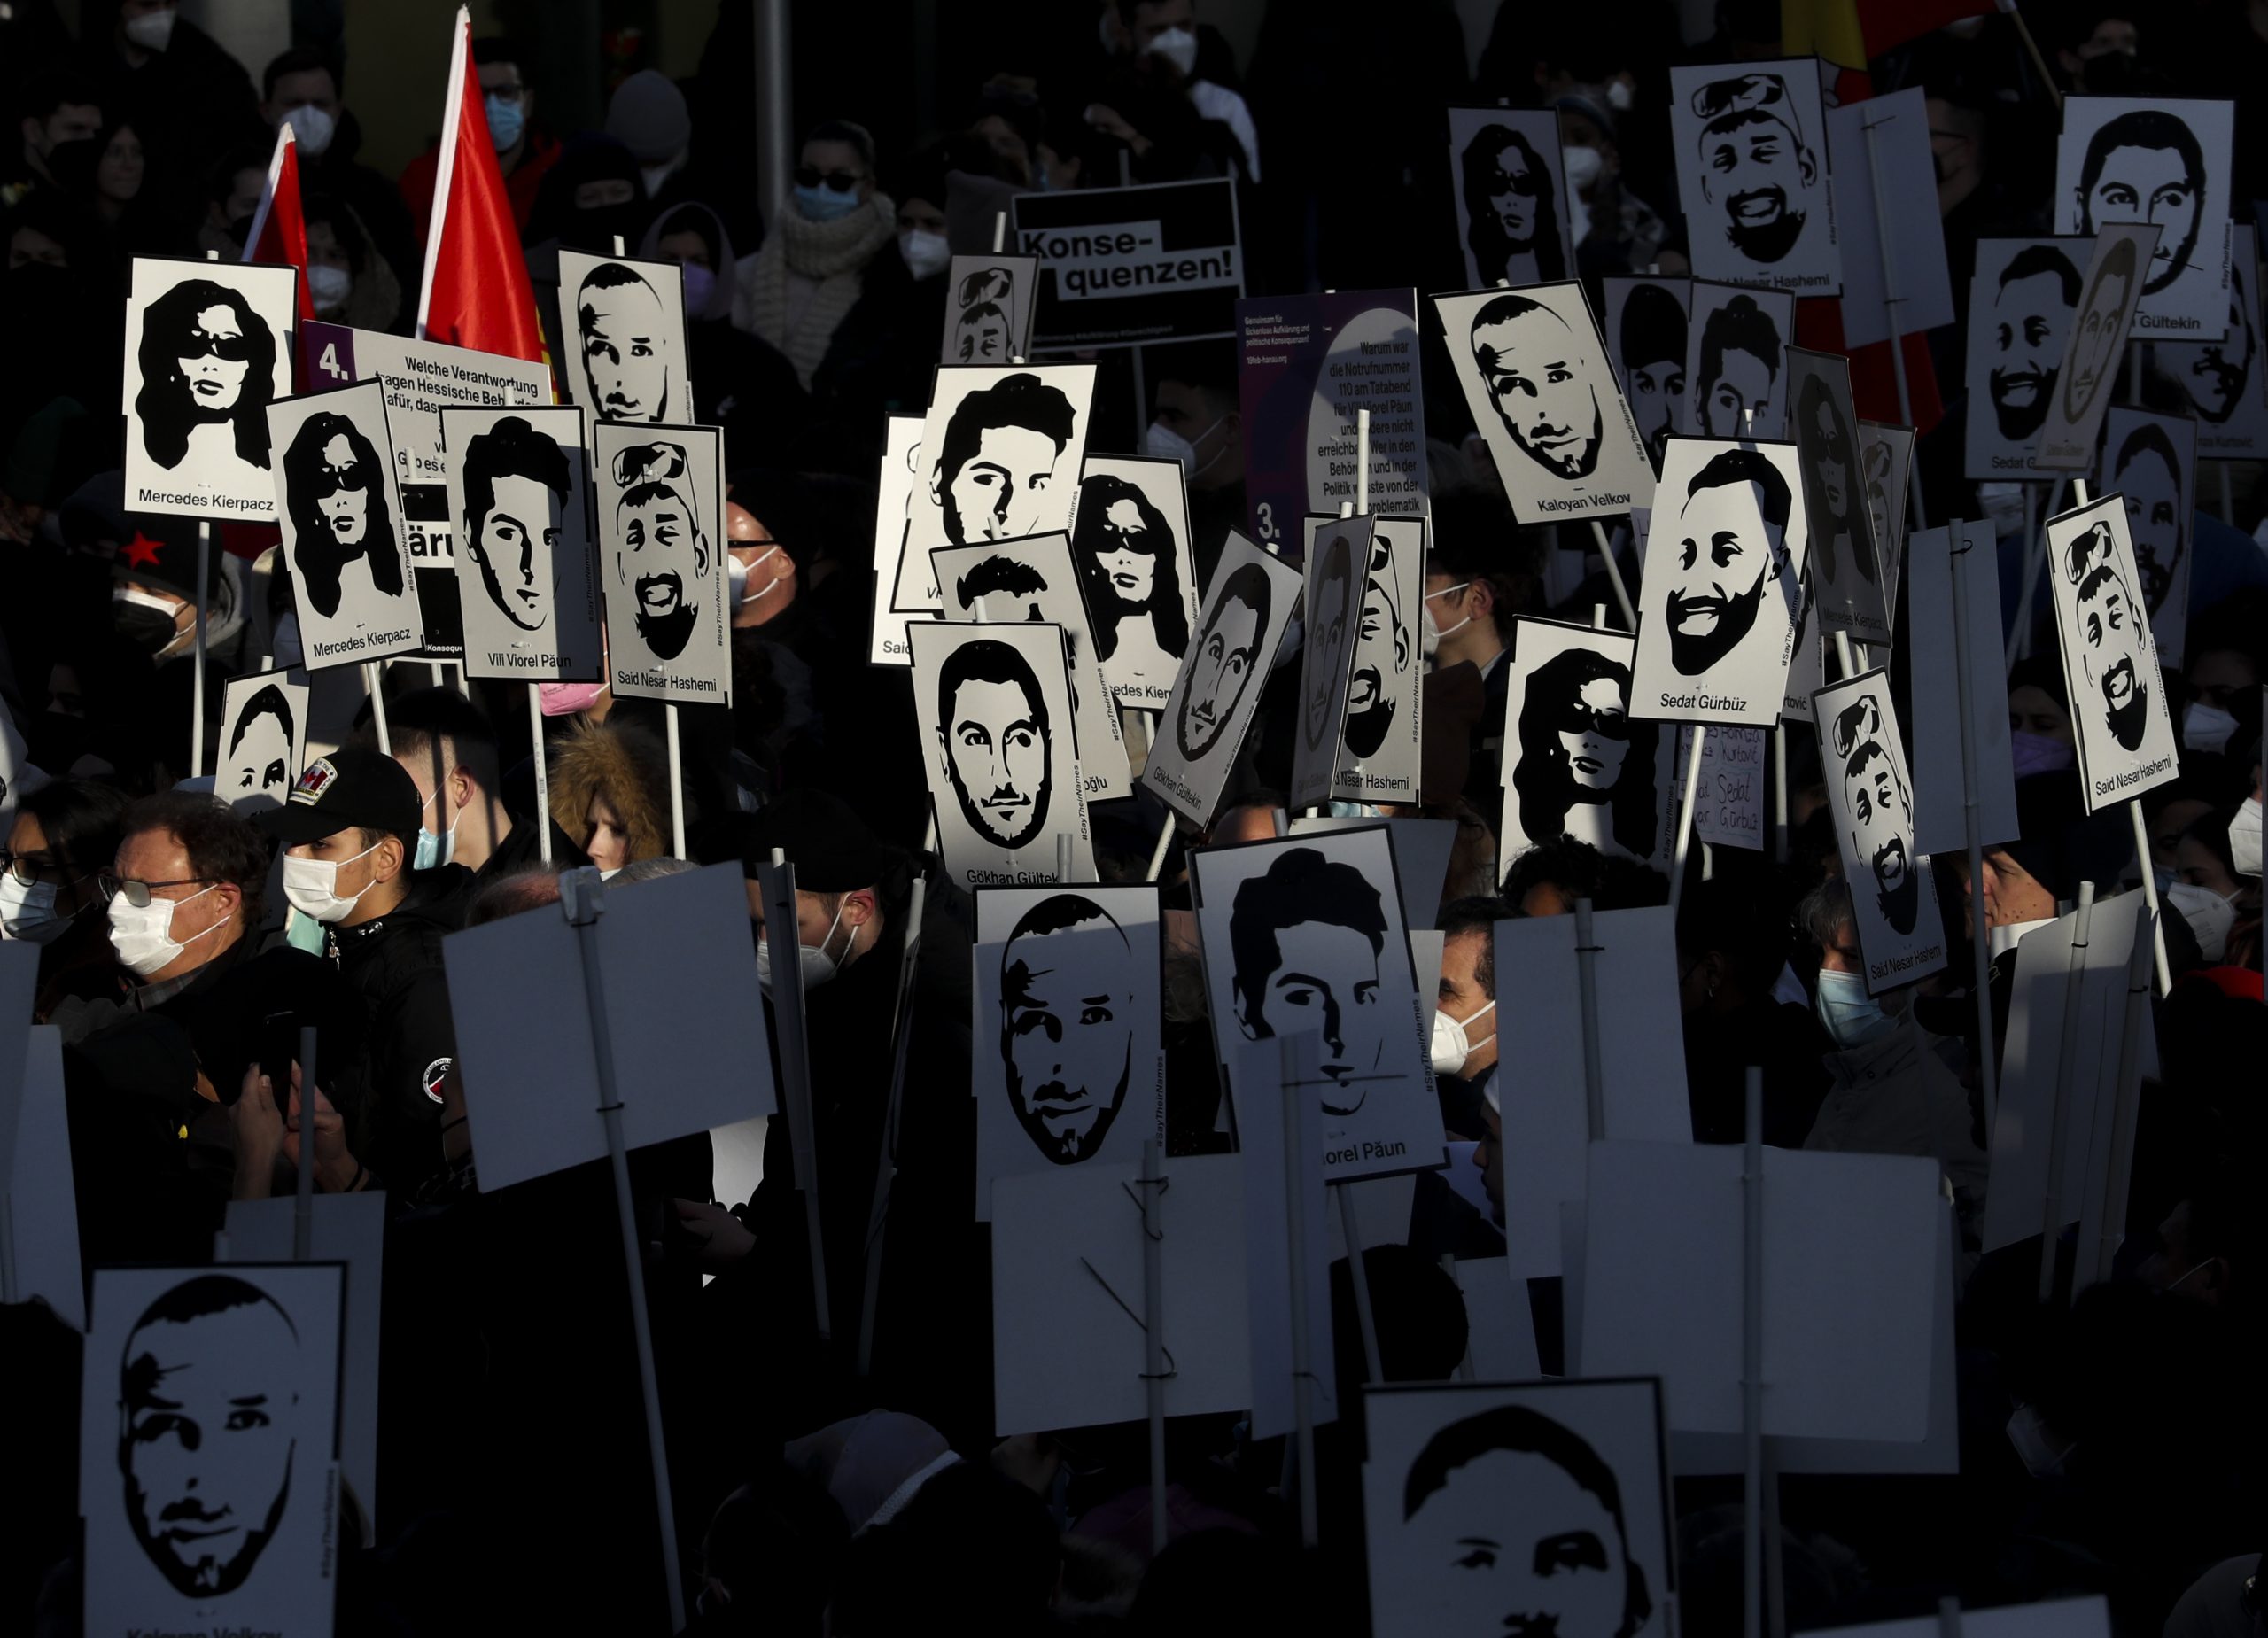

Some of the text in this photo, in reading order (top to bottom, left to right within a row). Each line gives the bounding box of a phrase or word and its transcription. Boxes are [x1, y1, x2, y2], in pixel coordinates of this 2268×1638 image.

[1024, 231, 1152, 259] Konse-
[2221, 223, 2233, 290] #SayTheirNames
[1066, 250, 1231, 297] quenzen!
[1774, 274, 1829, 288] Hashemi
[2140, 315, 2201, 330] Gültekin
[318, 342, 349, 381] 4.
[1360, 342, 1410, 356] Warum war
[405, 356, 538, 398] Welche Verantwortung
[1330, 361, 1410, 377] die Notrufnummer
[417, 377, 479, 402] Hessische
[1339, 379, 1411, 396] 110 am Tatabend
[1334, 403, 1347, 416] für
[1341, 423, 1357, 436] und
[1391, 419, 1414, 433] nicht
[1619, 399, 1645, 462] #SayTheirNames
[1389, 441, 1397, 453] in
[1398, 439, 1416, 453] den
[424, 459, 439, 472] es
[1374, 462, 1391, 475] und
[1392, 461, 1401, 473] in
[1402, 460, 1418, 472] der
[1992, 456, 2024, 470] Sedat
[139, 488, 275, 512] Mercedes Kierpacz
[1324, 482, 1351, 496] Politik
[1386, 482, 1402, 493] von
[1403, 479, 1418, 493] der
[1537, 493, 1632, 512] Kaloyan Velkov
[1256, 501, 1281, 540] 3.
[400, 518, 415, 592] #SayTheirNames
[584, 547, 595, 622] #SayTheirNames
[1782, 589, 1800, 666] #SayTheirNames
[314, 627, 412, 658] Mercedes Kierpacz
[488, 652, 572, 668] Vili Viorel Păun
[618, 671, 717, 693] Said Nesar Hashemi
[1097, 667, 1119, 741] #SayTheirNames
[1660, 693, 1747, 711] Sedat Gürbüz
[1224, 705, 1255, 775] #SayTheirNames
[1153, 766, 1202, 810] Gökhan Gültekin
[1340, 772, 1364, 788] Nesar
[1366, 774, 1410, 790] Hashemi
[1718, 773, 1751, 803] Sedat
[2096, 754, 2172, 796] Said Nesar Hashemi
[1073, 765, 1089, 840] #SayTheirNames
[1663, 786, 1674, 859] #SayTheirNames
[967, 869, 1014, 884] Gökhan
[1871, 942, 1942, 980] Said Nesar Hashemi
[1412, 999, 1434, 1092] #SayTheirNames
[1155, 1056, 1165, 1147] #SayTheirNames
[1363, 1140, 1407, 1160] Păun
